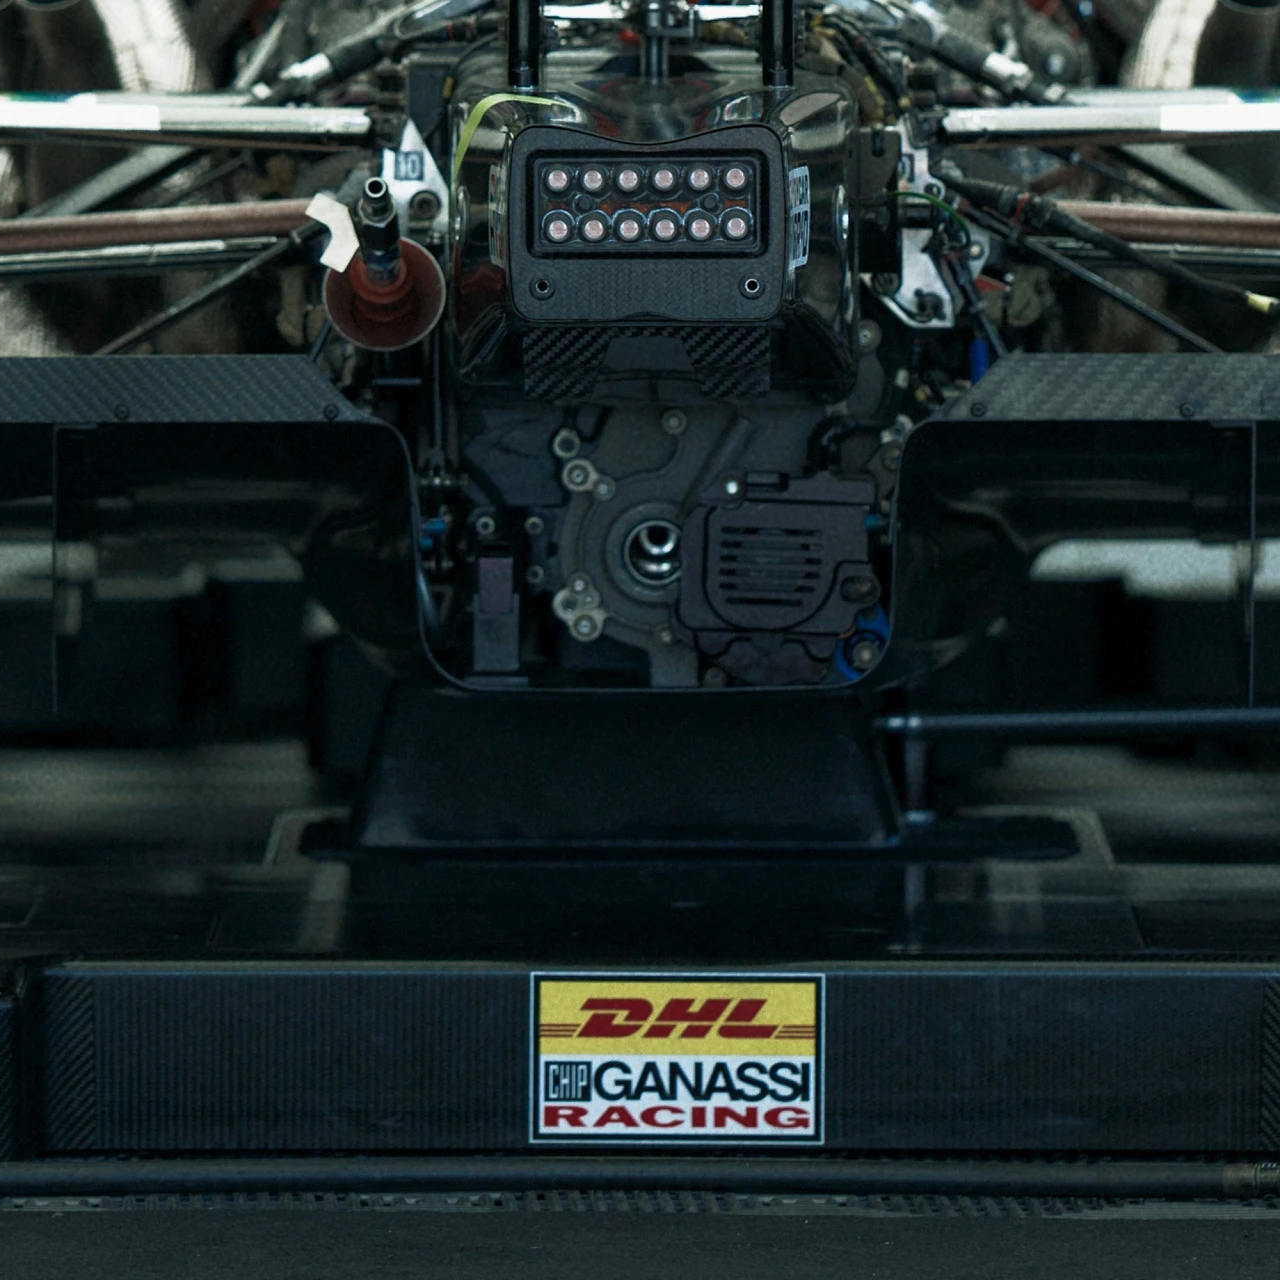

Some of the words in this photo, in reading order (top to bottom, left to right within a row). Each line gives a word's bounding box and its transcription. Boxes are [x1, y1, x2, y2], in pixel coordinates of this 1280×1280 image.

[577, 997, 780, 1039] DHL
[548, 1063, 589, 1100] CHIP
[593, 1060, 811, 1102] GANASSI
[543, 1104, 810, 1129] RACING
